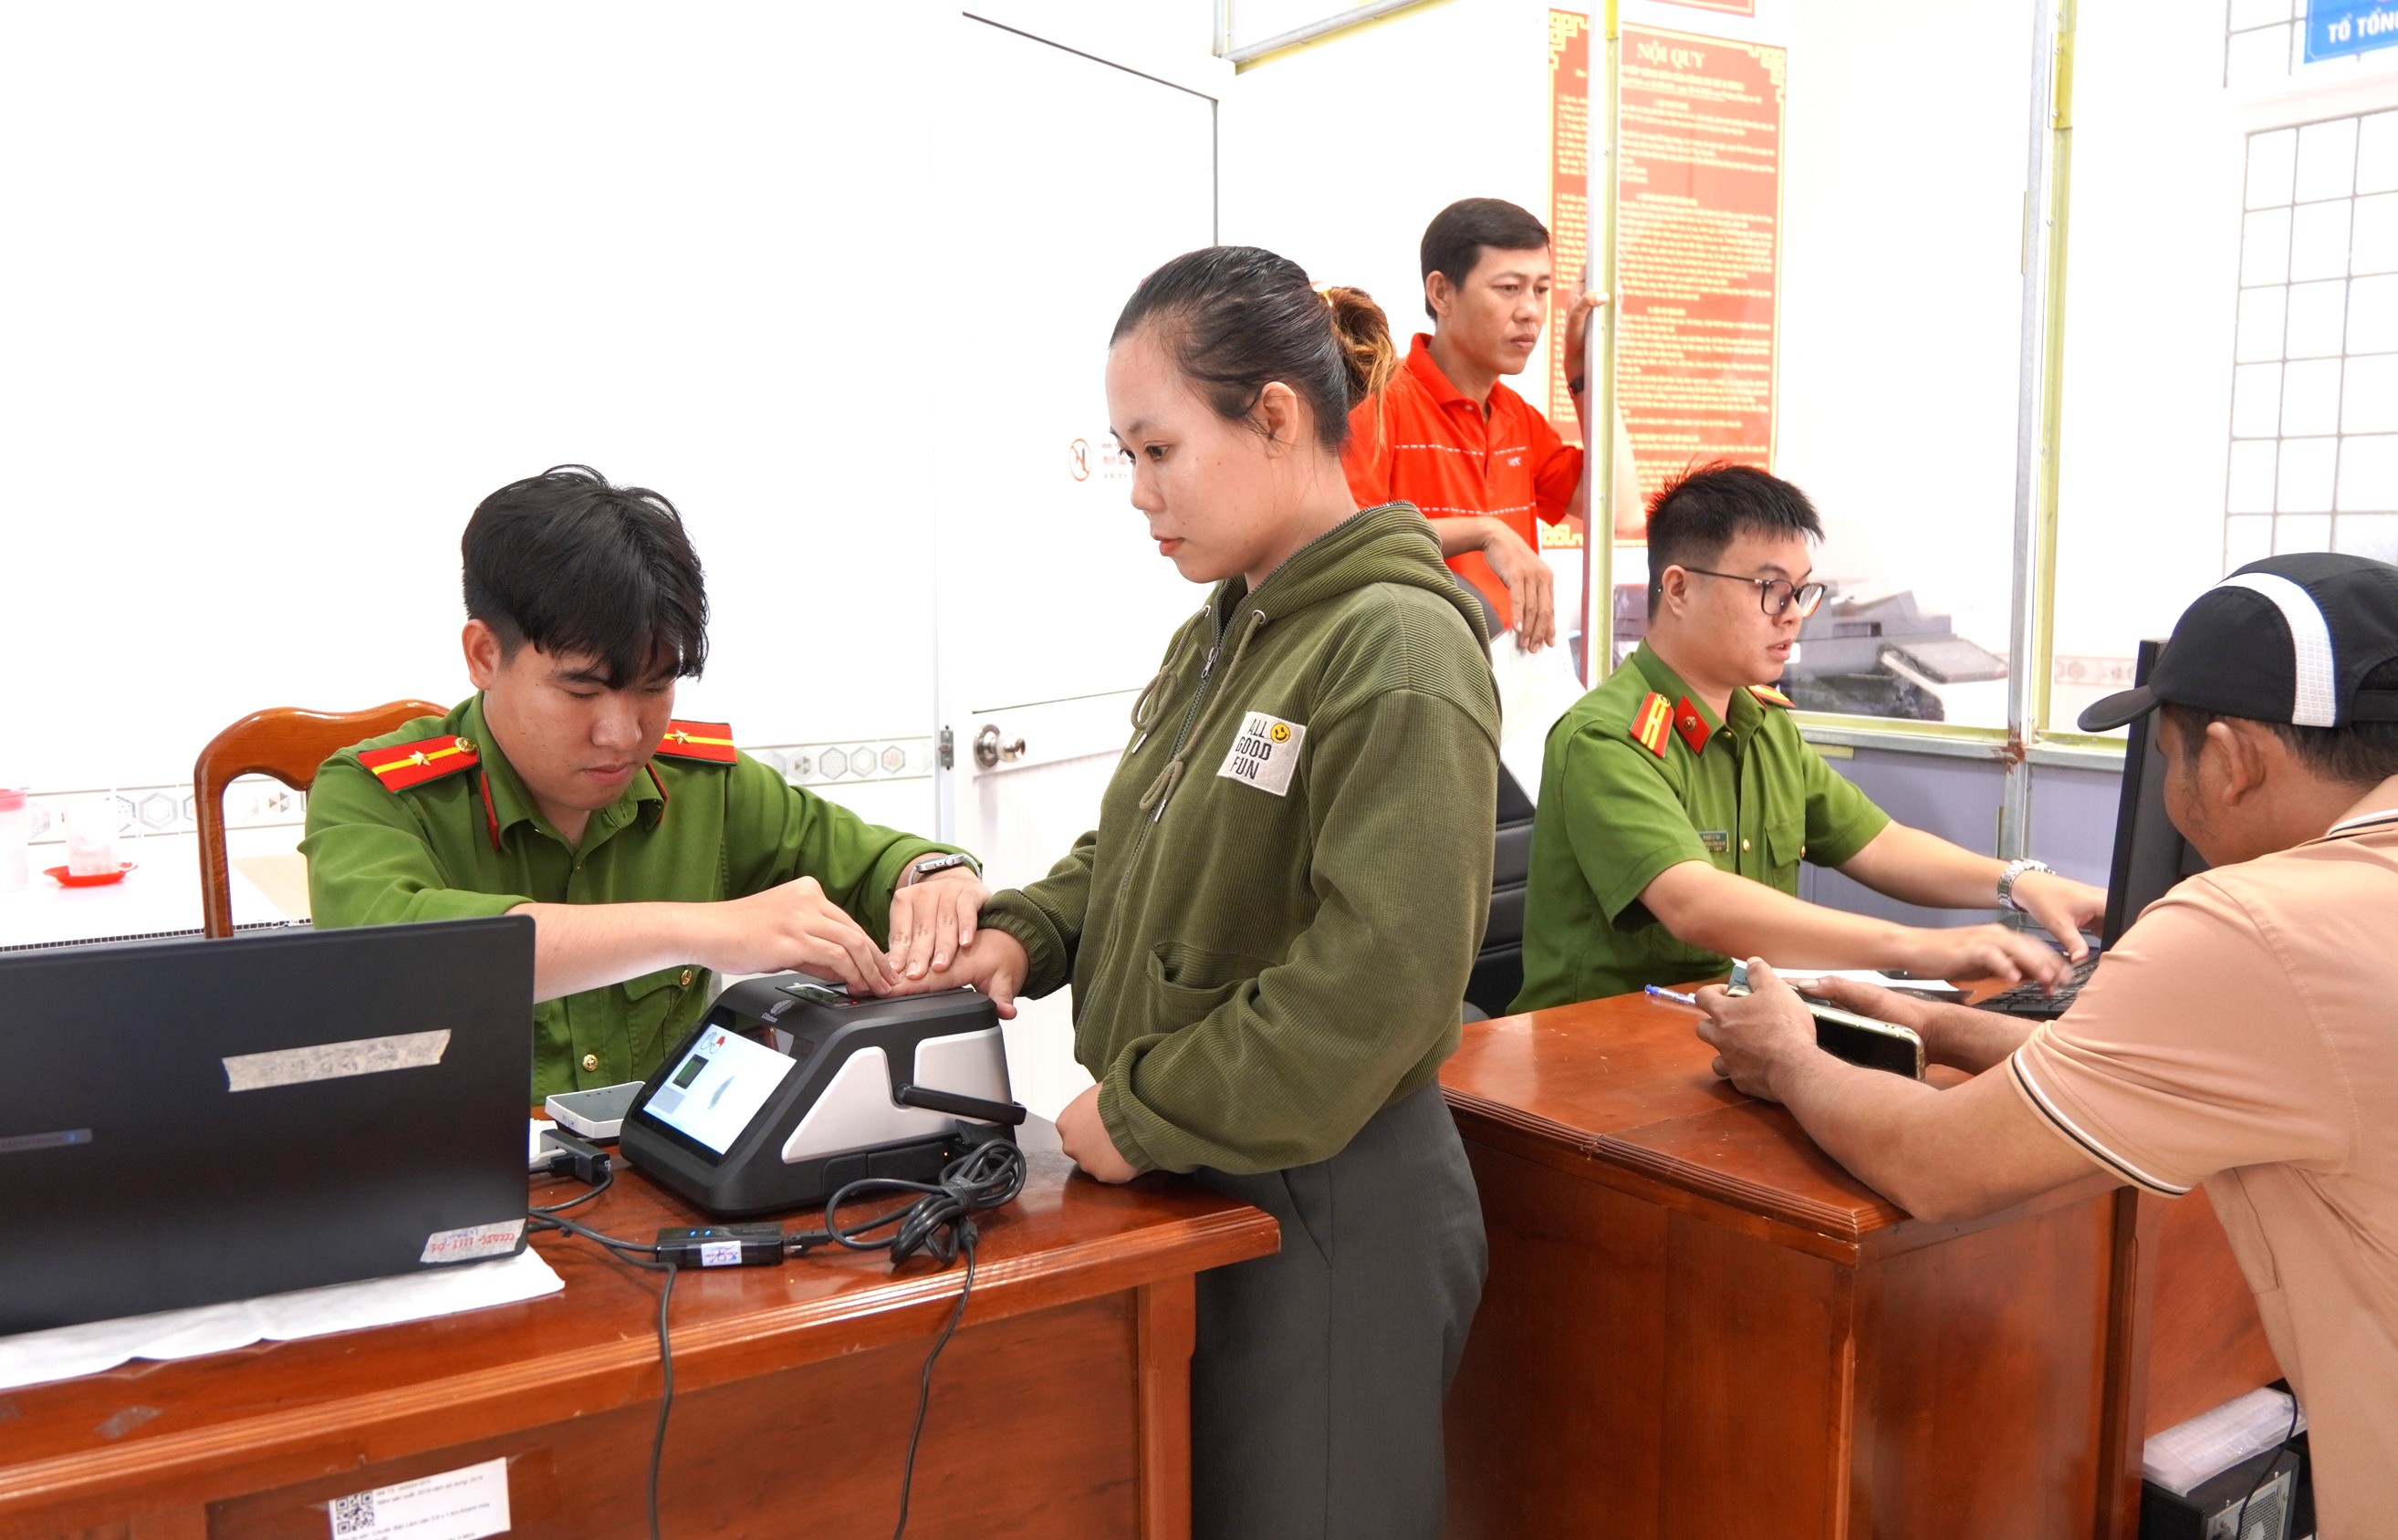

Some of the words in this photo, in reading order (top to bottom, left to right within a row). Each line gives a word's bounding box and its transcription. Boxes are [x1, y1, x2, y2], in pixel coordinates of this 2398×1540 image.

[2328, 13, 2352, 44] TỔ
[1637, 40, 1668, 65] NỘI
[1670, 47, 1705, 69] QUY
[1247, 719, 1267, 738] ALL
[1235, 736, 1272, 761] GOOD
[1230, 756, 1259, 780] FUN
